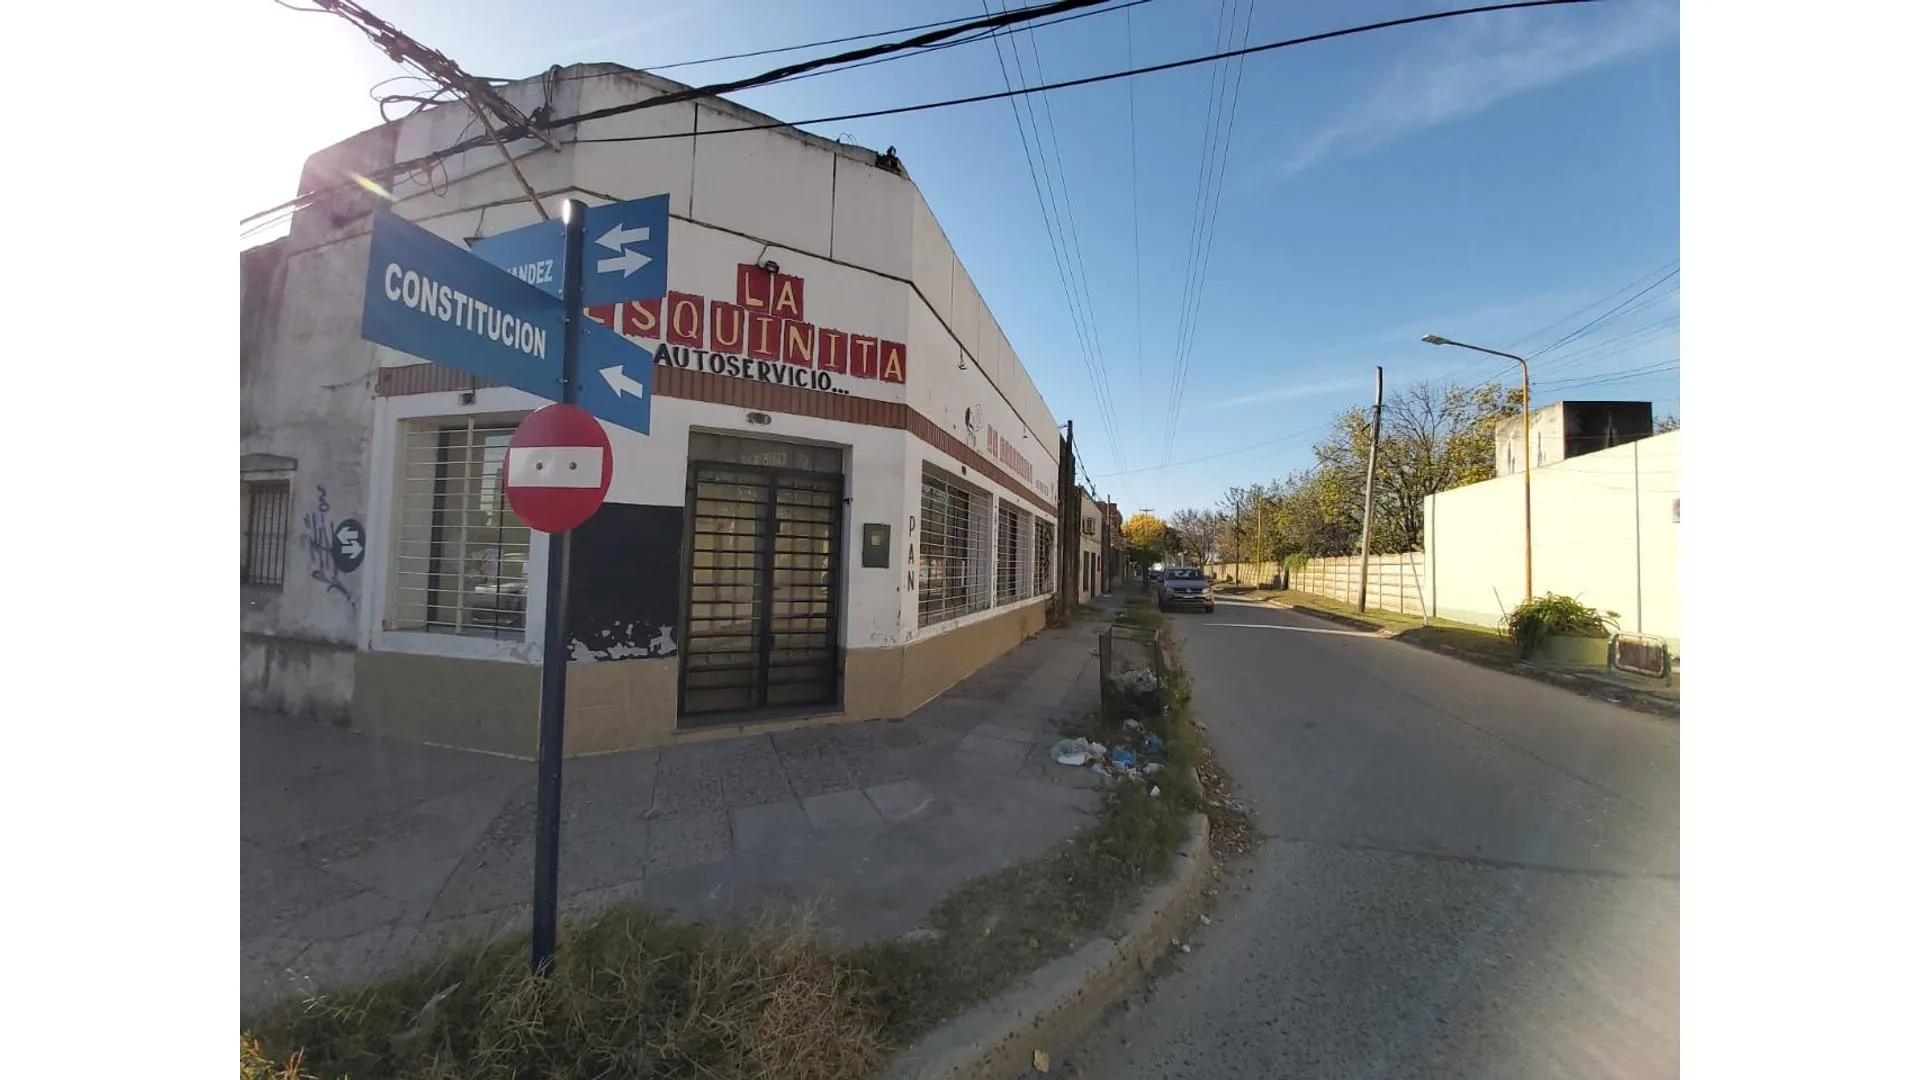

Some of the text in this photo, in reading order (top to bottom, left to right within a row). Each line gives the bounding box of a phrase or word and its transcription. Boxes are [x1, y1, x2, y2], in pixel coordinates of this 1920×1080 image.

[507, 259, 553, 285] ANDEZ
[746, 272, 798, 314] LA
[385, 262, 546, 359] CONSTITUCION
[906, 515, 916, 592] PAN
